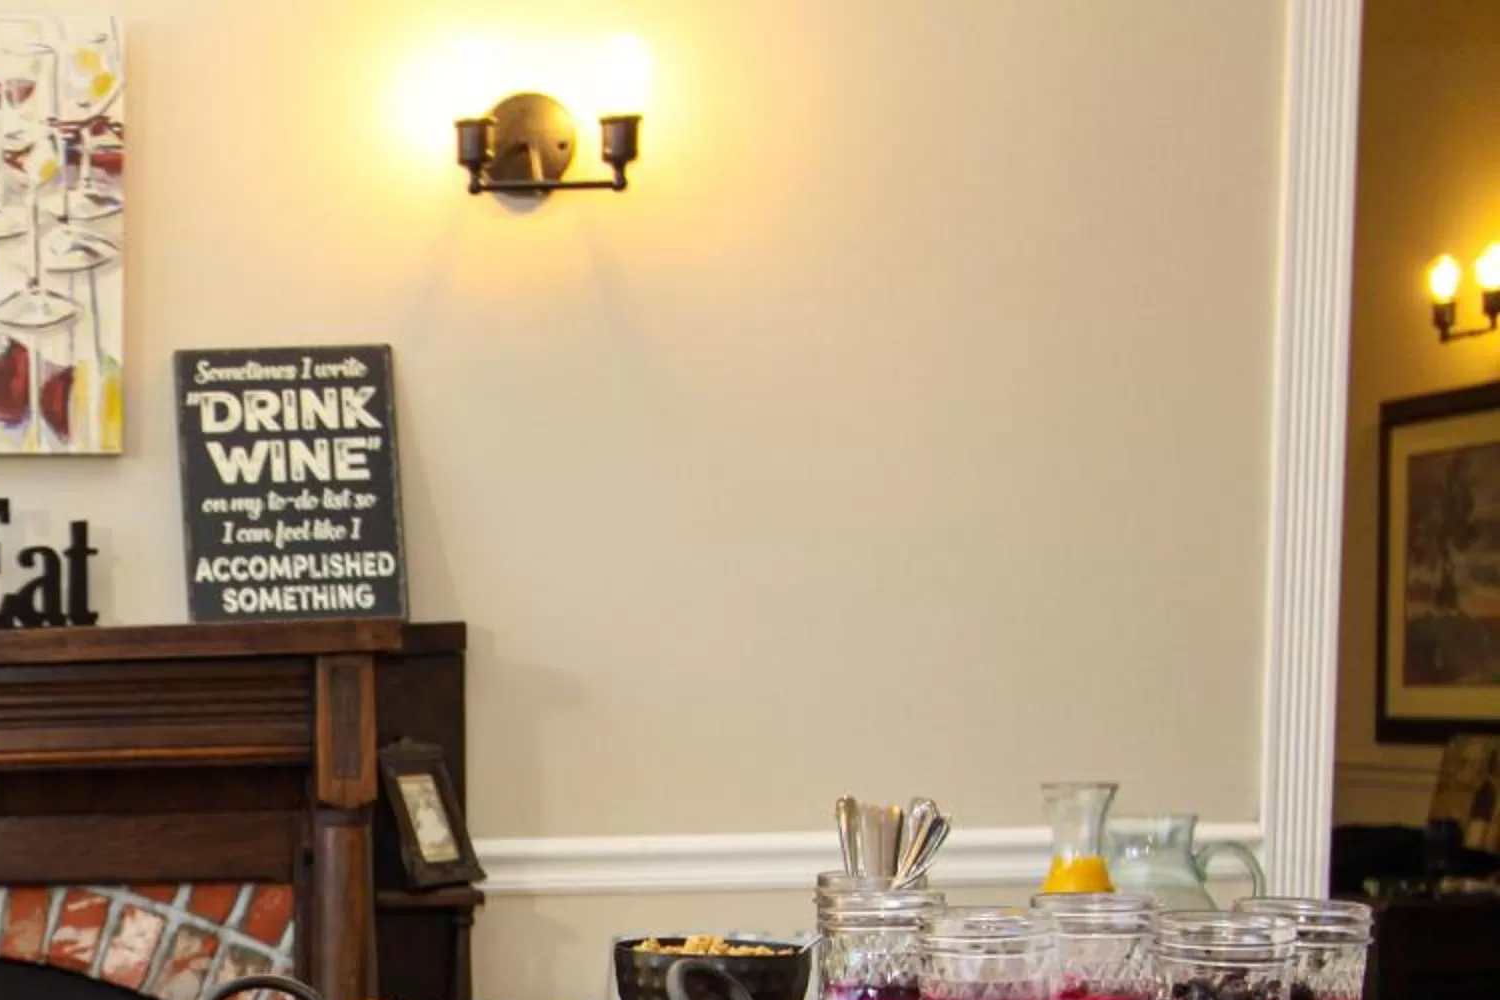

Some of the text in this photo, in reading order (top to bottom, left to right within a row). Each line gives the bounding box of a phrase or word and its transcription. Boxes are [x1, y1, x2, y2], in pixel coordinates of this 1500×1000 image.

[194, 356, 369, 384] Sometimes I write
[202, 487, 377, 520] on my to-do list so
[222, 516, 363, 549] I can feel like I
[195, 551, 396, 582] ACCOMPLISHED
[222, 583, 376, 613] SOMETHING
